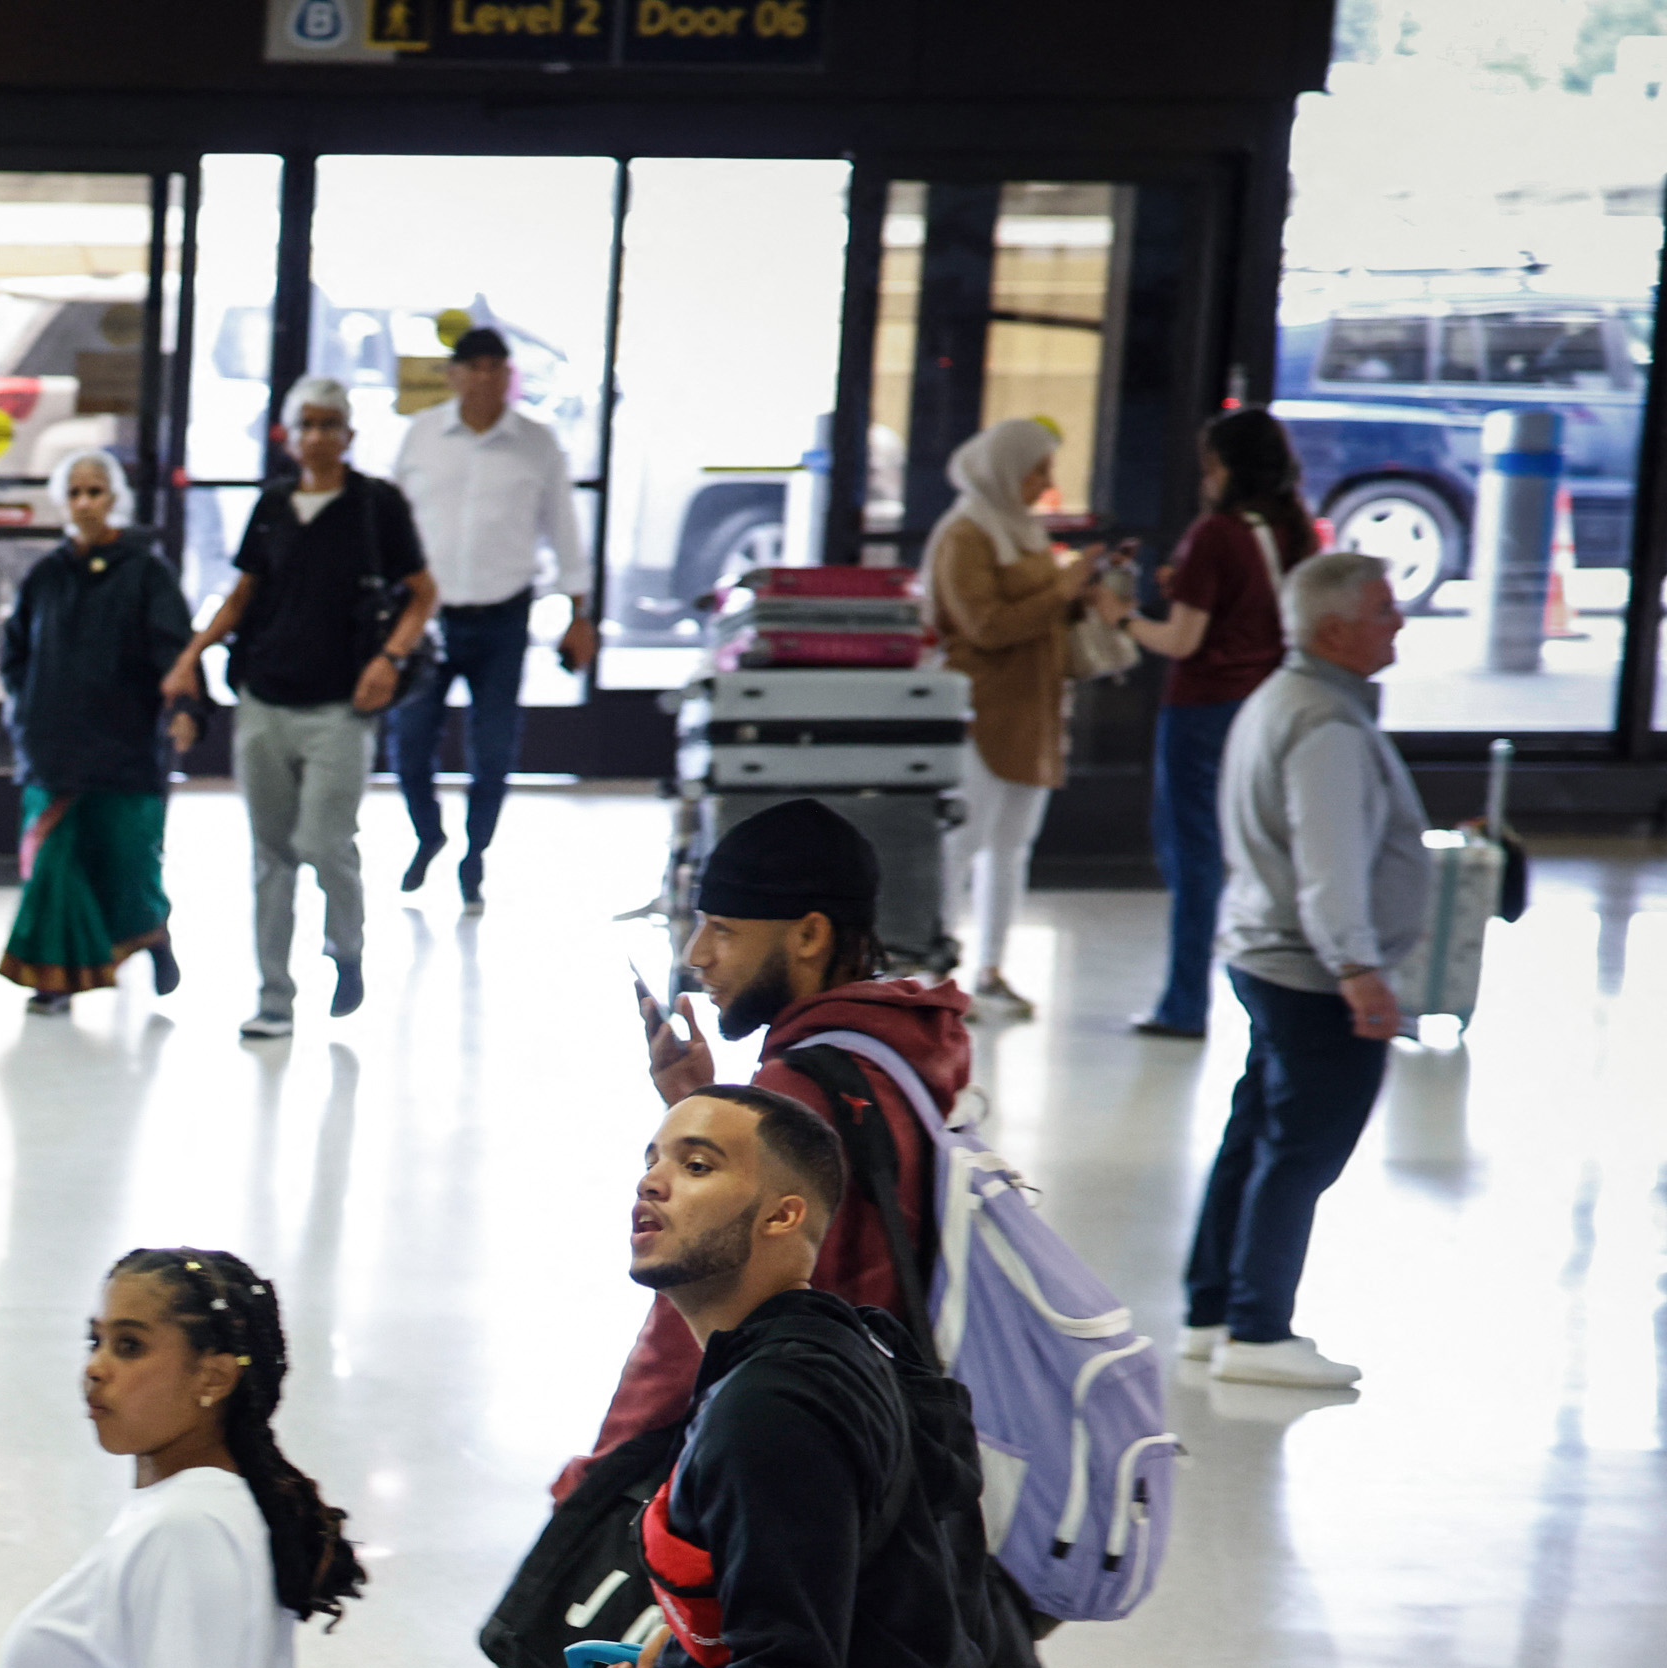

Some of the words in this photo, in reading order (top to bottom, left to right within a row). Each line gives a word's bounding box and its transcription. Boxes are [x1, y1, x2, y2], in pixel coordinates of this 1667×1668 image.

[451, 0, 562, 34] Level
[574, 0, 600, 35] 2
[637, 0, 744, 37] Door
[753, 0, 806, 38] 06
